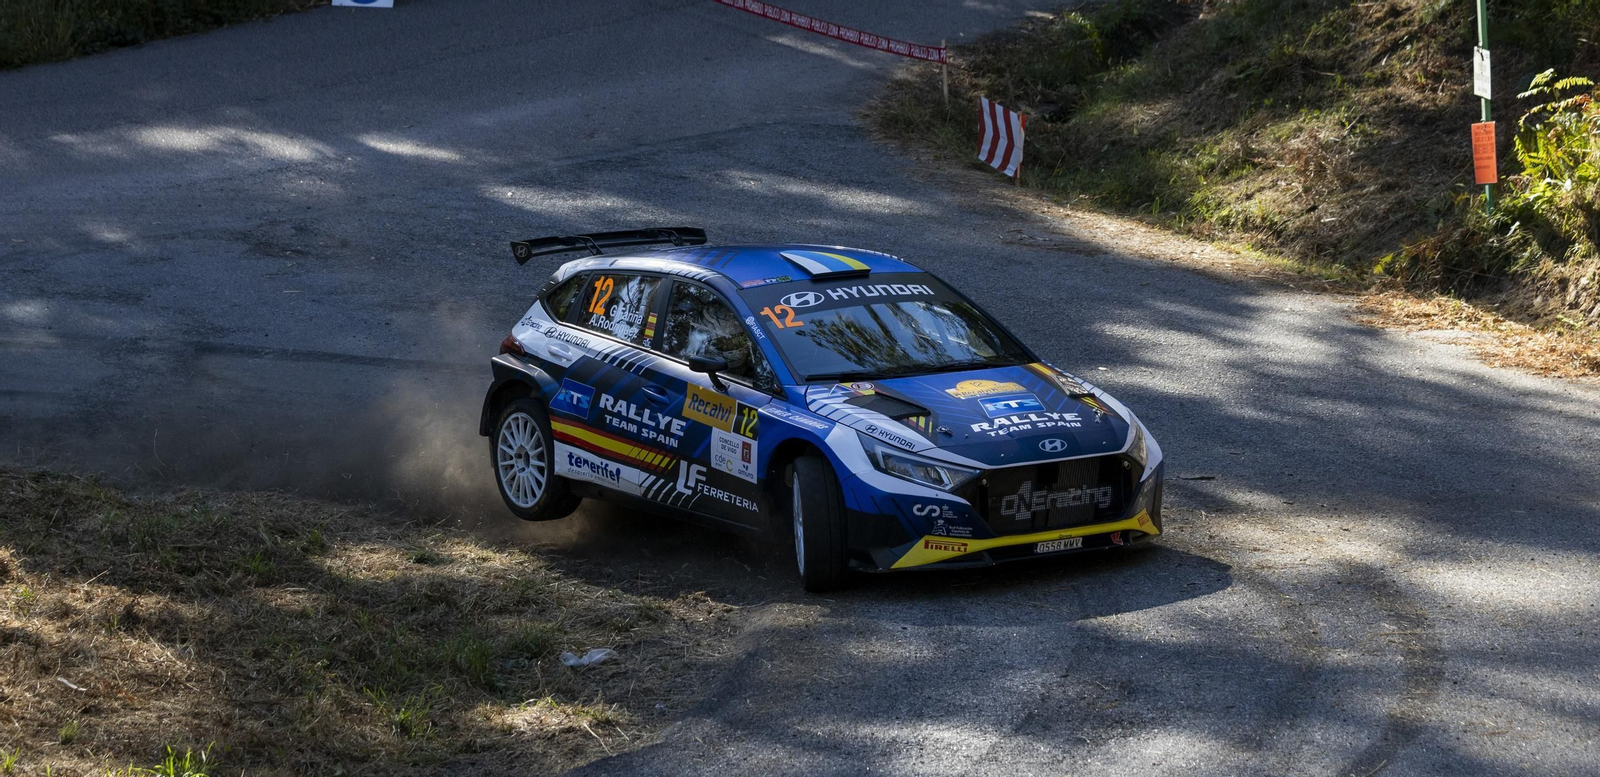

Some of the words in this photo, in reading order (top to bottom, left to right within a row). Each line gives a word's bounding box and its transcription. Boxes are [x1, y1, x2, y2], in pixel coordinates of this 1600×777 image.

[780, 10, 790, 22] ZONA
[791, 12, 811, 28] PROHIBIDO
[812, 20, 827, 33] PUBLICO
[828, 24, 838, 36] ZONA
[839, 27, 859, 43] PROHIBIDO
[860, 33, 877, 47] PUBLICO
[877, 38, 888, 49] ZONA
[888, 40, 910, 54] PROHIBIDO
[910, 45, 927, 58] PUBLICO
[928, 49, 939, 61] ZONA
[588, 276, 614, 315] 12
[826, 284, 935, 301] HYUNDAI
[760, 304, 804, 329] 12
[556, 330, 591, 348] HYUNDAI
[557, 388, 590, 408] RTS
[688, 393, 732, 422] Recalvi
[986, 398, 1039, 412] RTS
[599, 393, 686, 436] RALLYE
[740, 408, 758, 438] 12
[970, 412, 1082, 432] RALLYE
[604, 414, 637, 433] TEAM
[641, 428, 679, 448] SPAIN
[987, 424, 1032, 437] TEAM
[1038, 420, 1082, 430] SPAIN
[719, 436, 740, 449] CONCELLO
[878, 429, 916, 450] HYUNDAI
[676, 459, 707, 495] LF
[697, 482, 759, 513] FERRETERIA
[924, 540, 968, 552] PIRELLI
[1039, 541, 1062, 552] 0558
[1063, 538, 1081, 549] MMV
